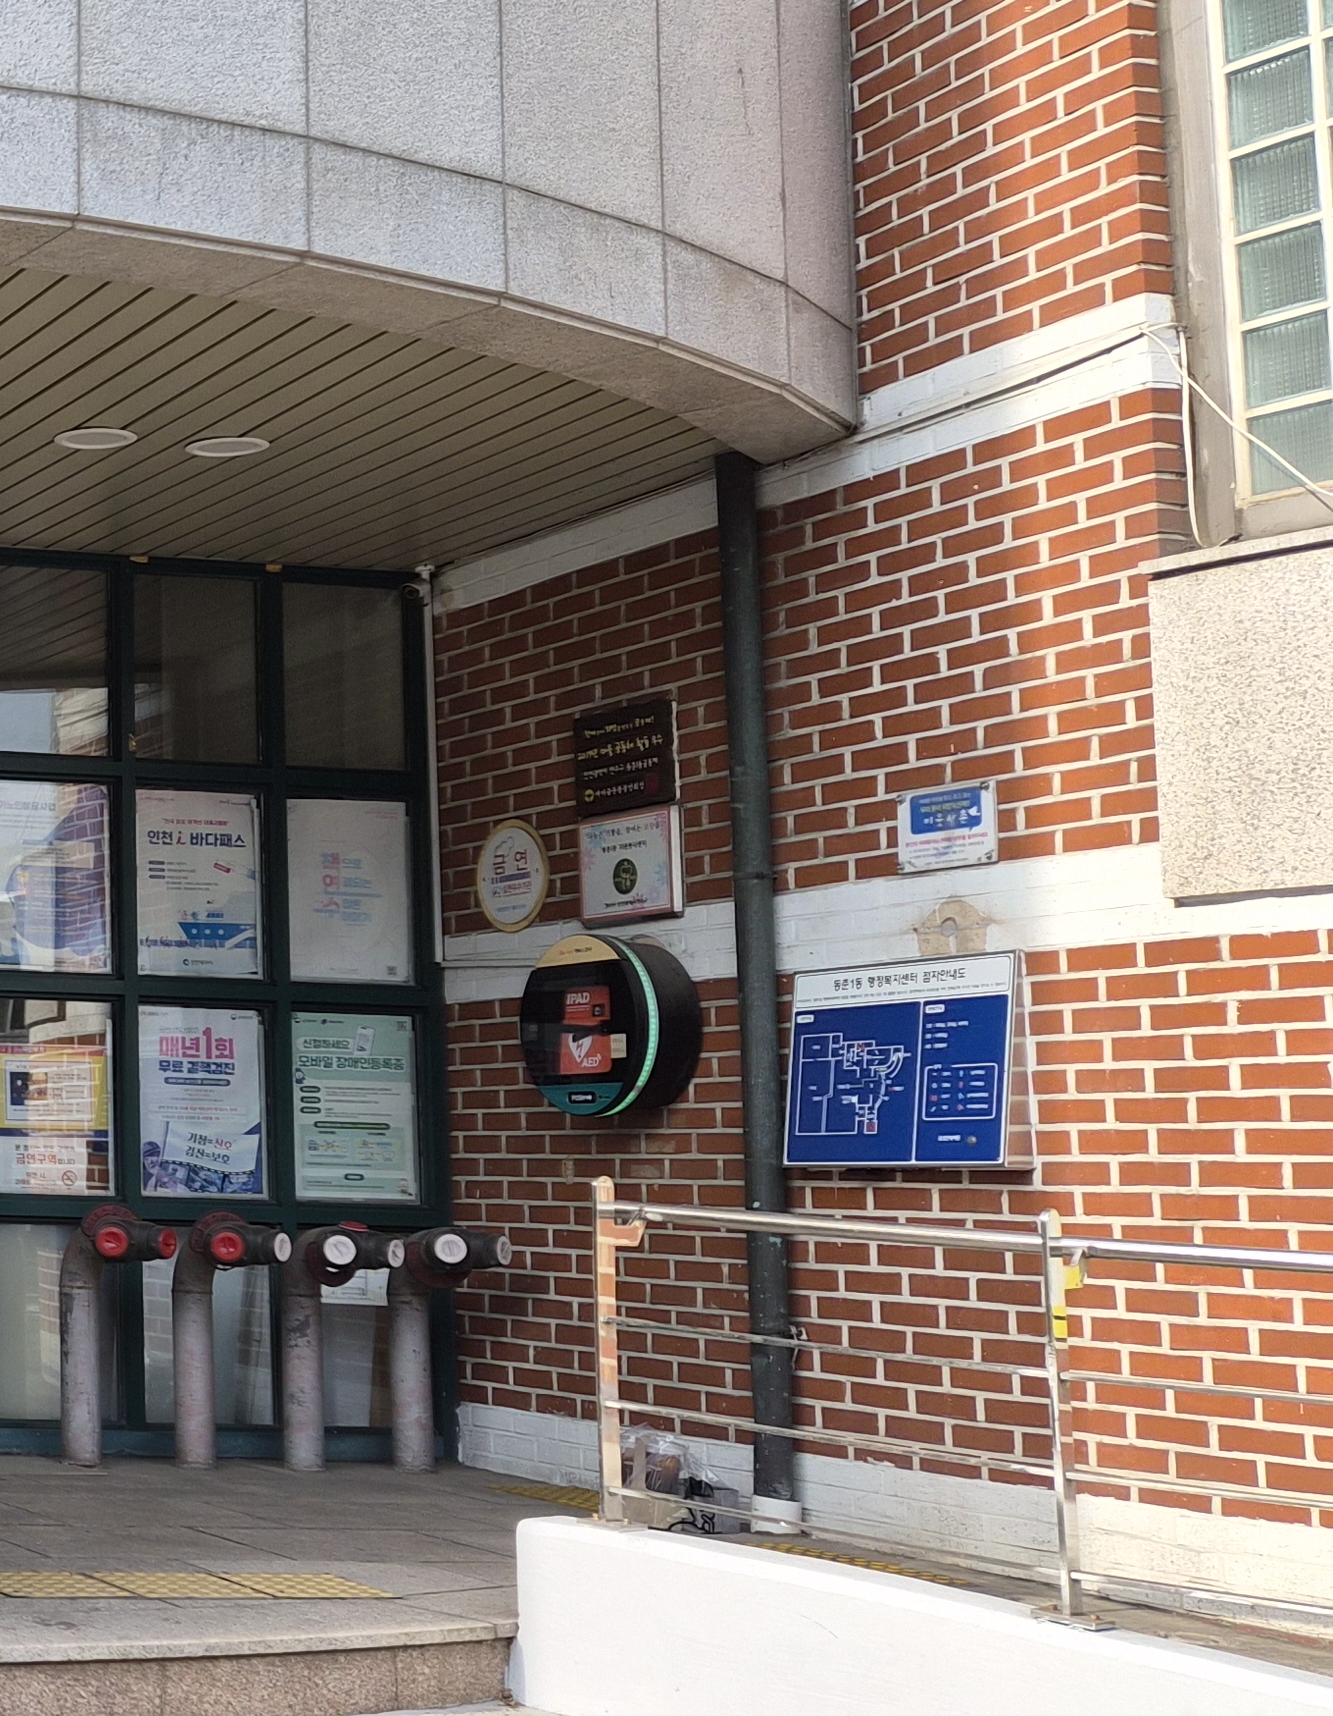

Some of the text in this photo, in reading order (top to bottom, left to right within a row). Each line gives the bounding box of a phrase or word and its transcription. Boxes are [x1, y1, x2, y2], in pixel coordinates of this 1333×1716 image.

[148, 830, 173, 845] 인천
[190, 832, 246, 848] 바다패스
[833, 967, 967, 992] 동춘1동 행정복지센터 점자안내도
[566, 992, 590, 1005] IPAD
[158, 1027, 235, 1060] 매년1회
[158, 1060, 236, 1075] 무료 결핵검진
[298, 1055, 406, 1071] 모바일 장애인등록증
[582, 1058, 600, 1068] AED
